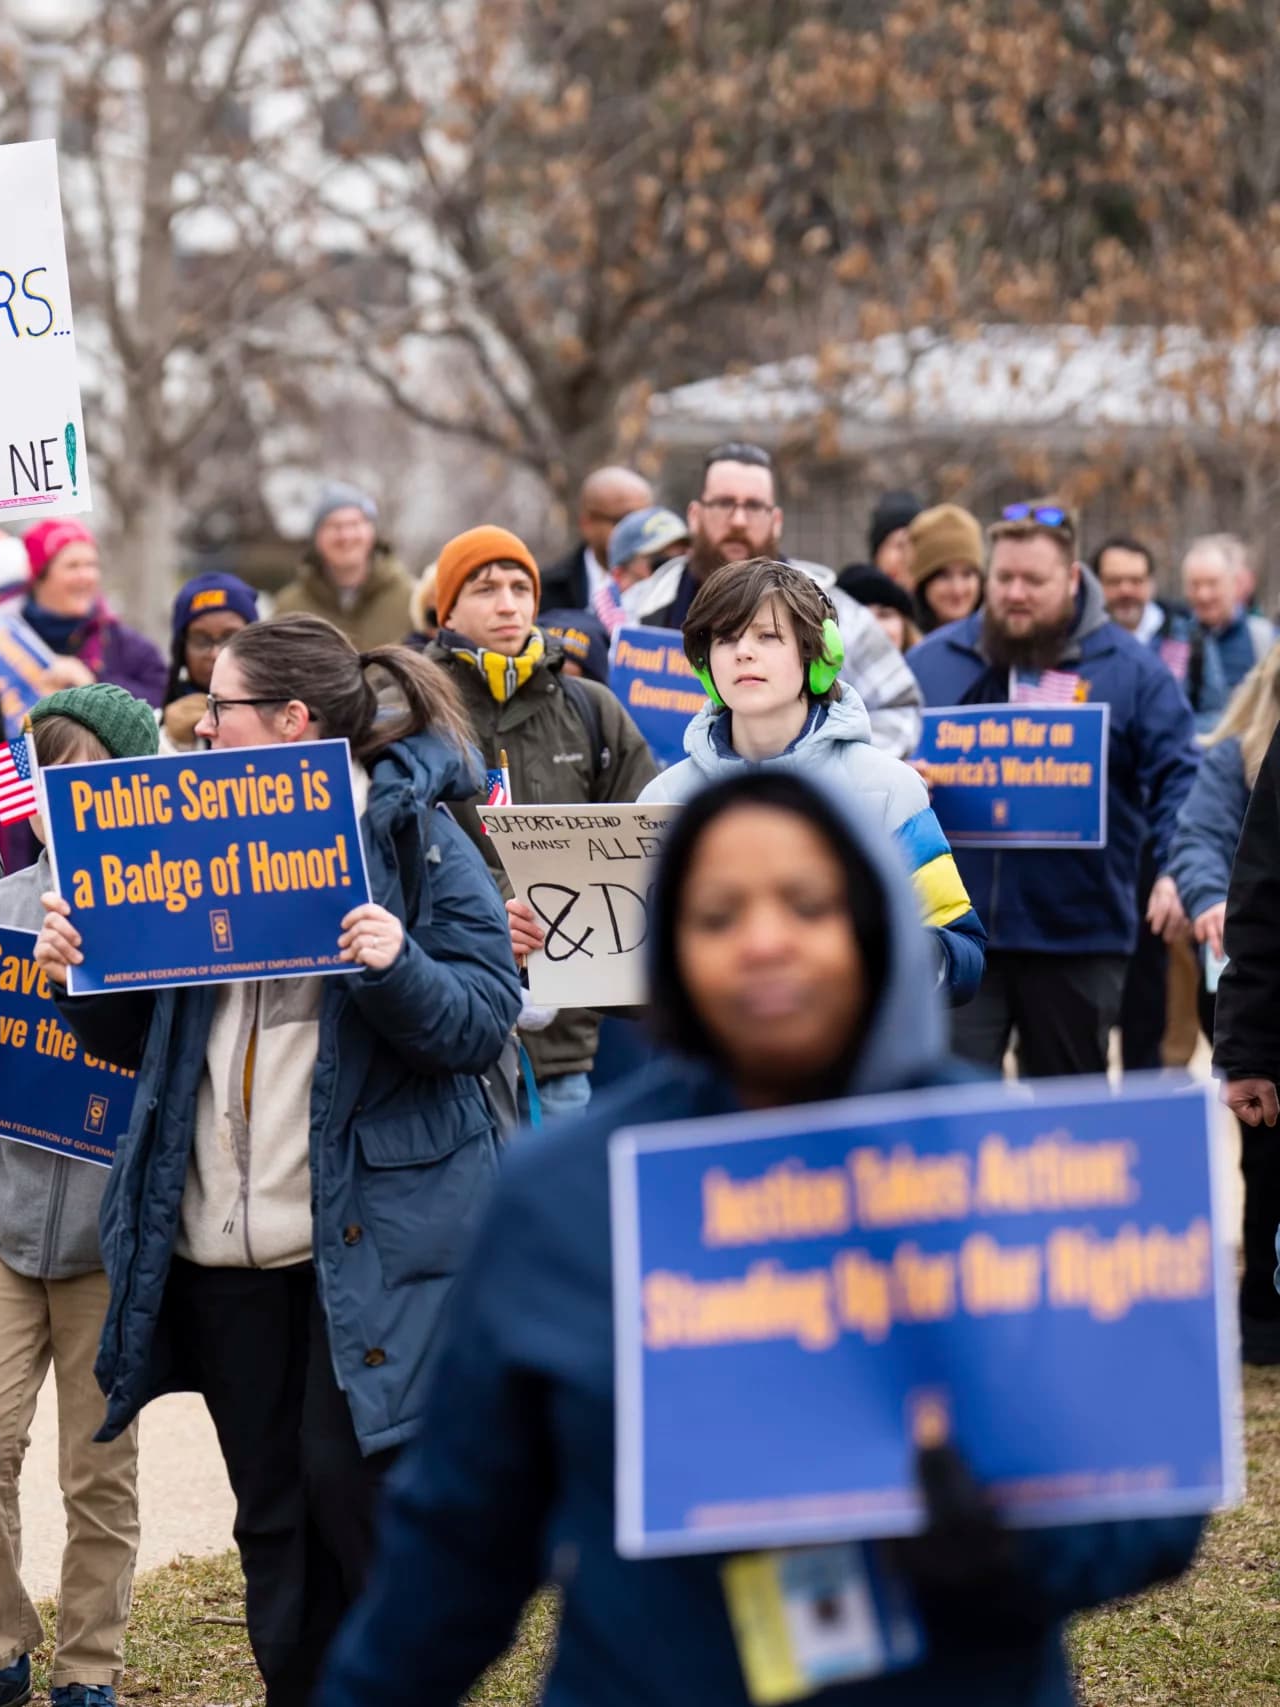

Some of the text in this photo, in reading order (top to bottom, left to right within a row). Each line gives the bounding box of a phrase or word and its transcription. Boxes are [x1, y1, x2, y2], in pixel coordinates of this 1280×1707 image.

[936, 716, 1074, 753] Stop the War on
[1000, 755, 1093, 787] Workforce
[70, 758, 331, 833] Public Service is
[483, 815, 555, 834] SUPPORT
[563, 815, 621, 831] DEFEND
[511, 838, 572, 851] AGAINST
[588, 837, 642, 861] ALL
[72, 833, 352, 914] a Badge of Honor!
[527, 882, 595, 962] &
[104, 967, 148, 984] AMERICAN
[148, 964, 198, 981] FEDERATION
[198, 963, 210, 976] OF
[210, 960, 267, 975] GOVERNMENT
[35, 1017, 78, 1061] the
[12, 1122, 61, 1143] FEDERATION
[61, 1135, 74, 1147] OF
